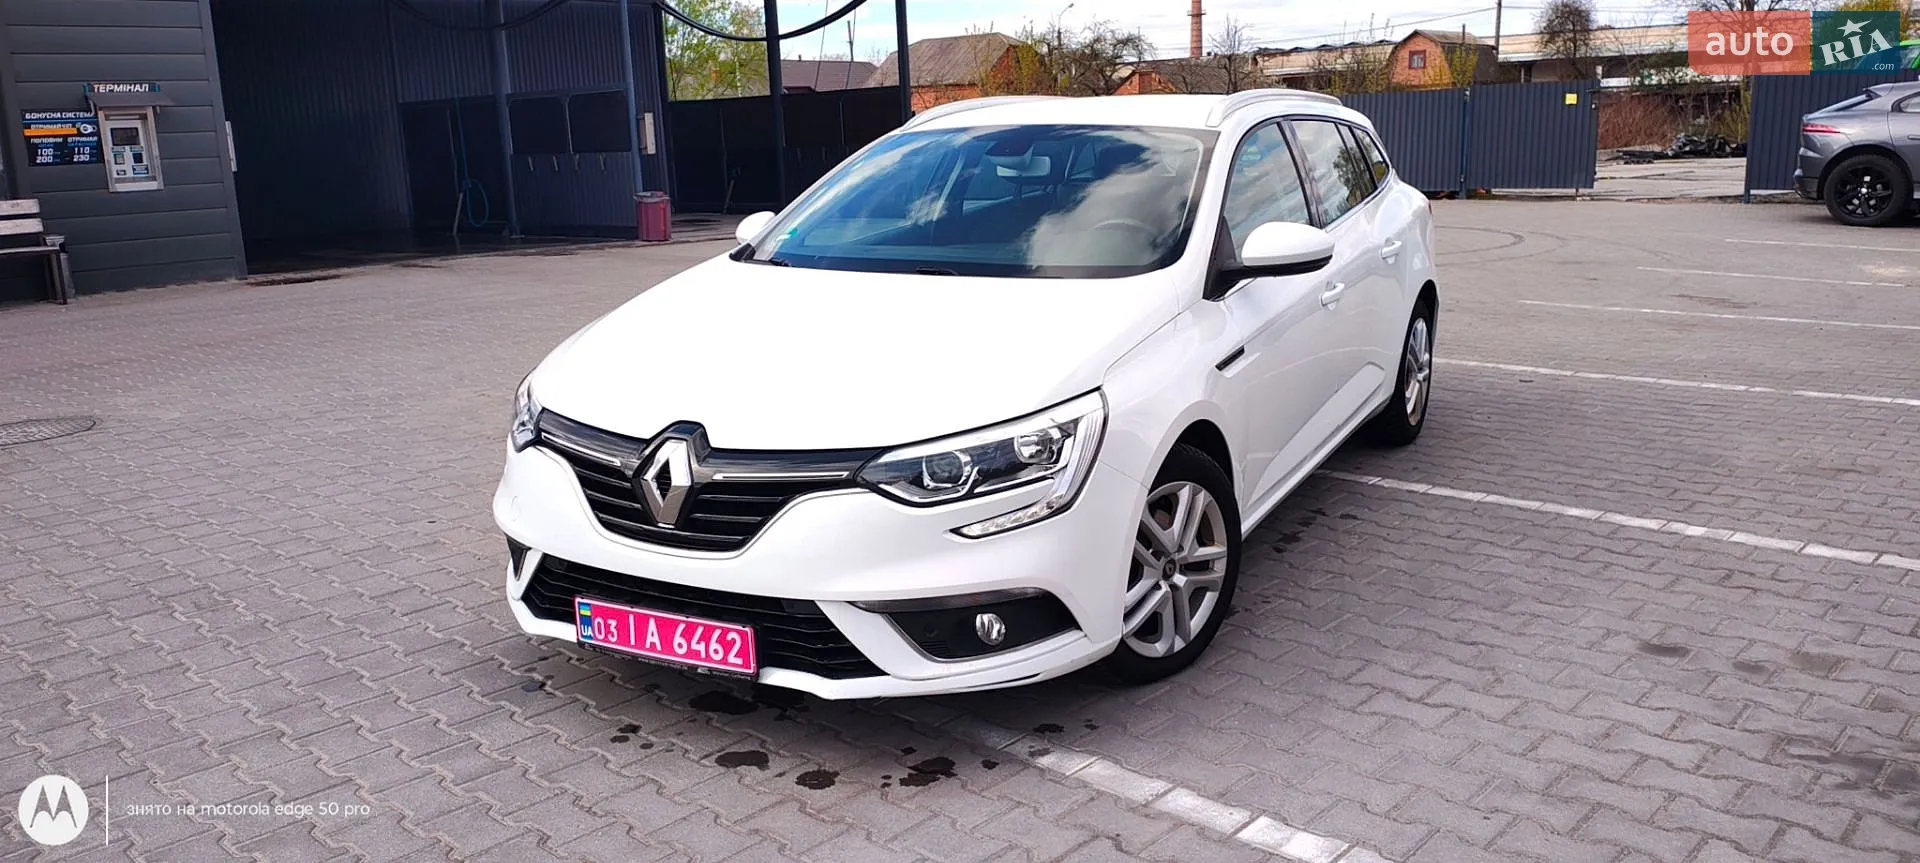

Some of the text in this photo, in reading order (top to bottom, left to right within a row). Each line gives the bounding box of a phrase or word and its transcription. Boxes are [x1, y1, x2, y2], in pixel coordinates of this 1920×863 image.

[93, 83, 149, 93] ТЕРМІНАЛ
[25, 111, 60, 119] БОНУСНА
[73, 154, 90, 162] 230
[581, 624, 593, 637] UA
[593, 617, 618, 642] 03
[672, 623, 743, 665] 6462
